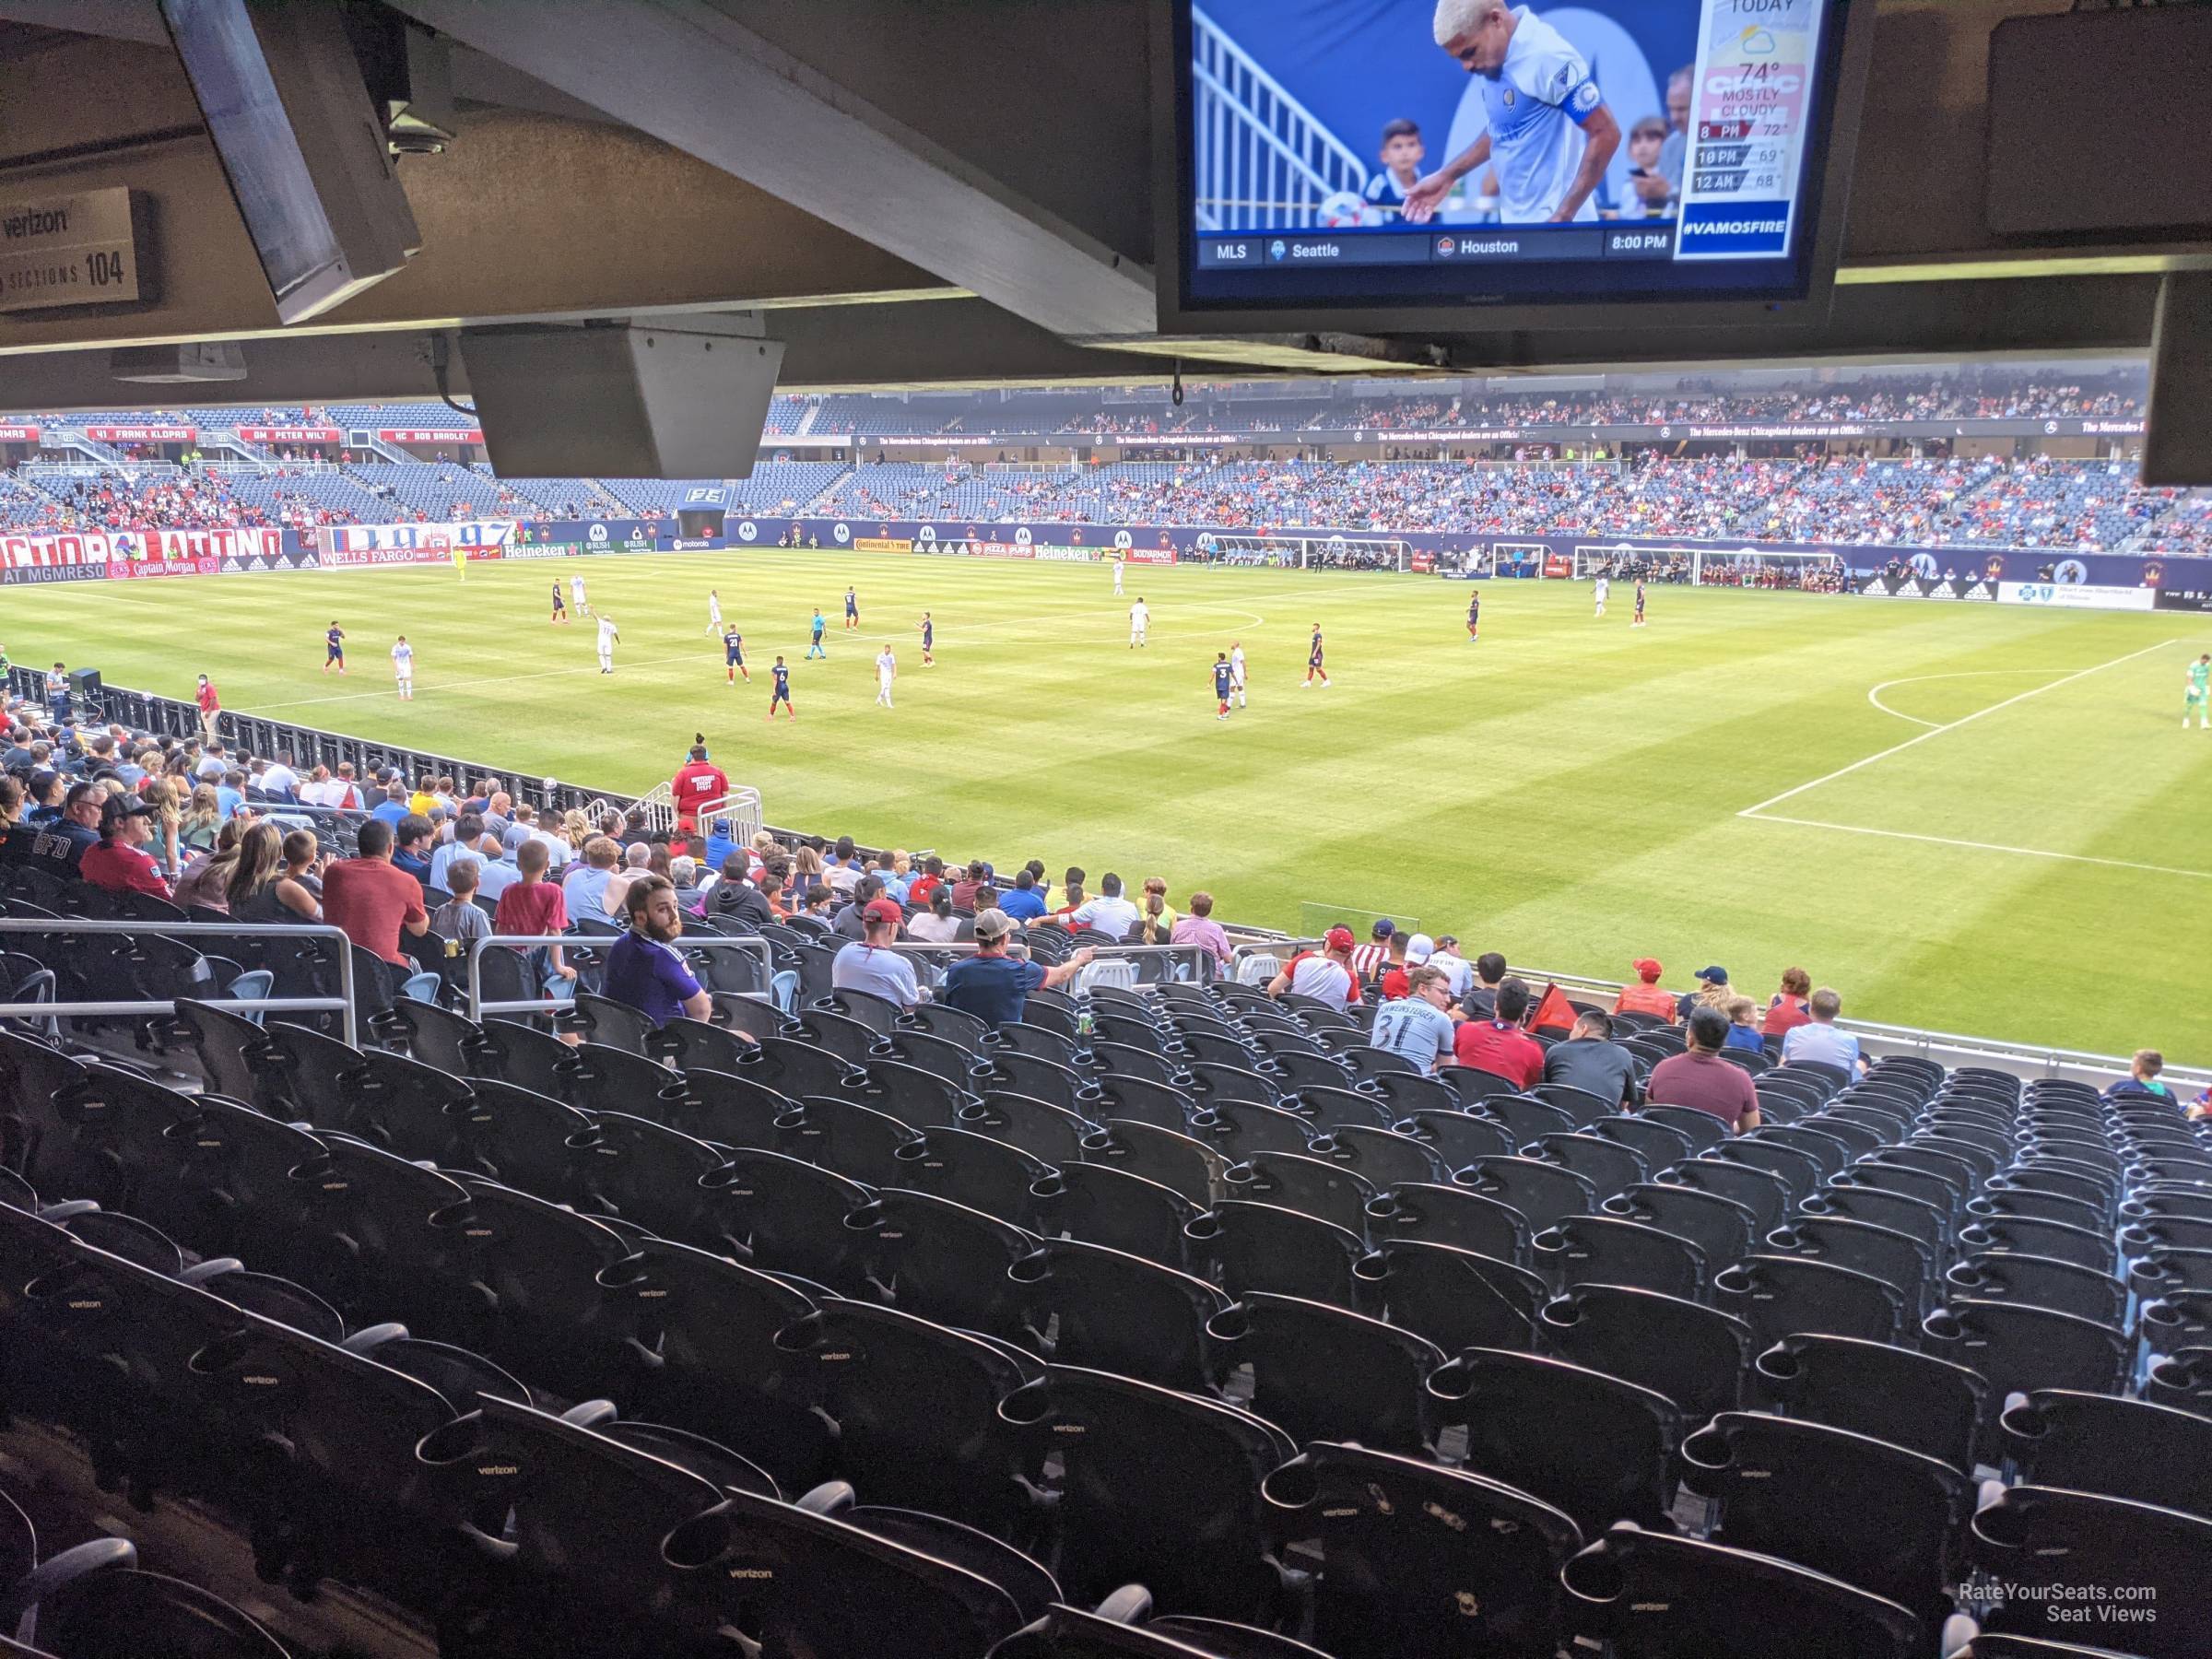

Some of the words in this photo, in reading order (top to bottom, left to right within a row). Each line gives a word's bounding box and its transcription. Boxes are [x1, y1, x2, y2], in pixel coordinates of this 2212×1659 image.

[1733, 0, 1793, 13] TODAY
[1723, 88, 1780, 101] MOSTLY
[1722, 103, 1778, 117] CLOUDY
[1700, 125, 1710, 139] 8
[1721, 125, 1739, 138] PM
[1698, 151, 1717, 164] 10
[1718, 150, 1736, 163] PM
[1696, 175, 1712, 189] 12
[1714, 175, 1734, 188] AM
[2, 206, 68, 239] verizon
[1684, 220, 1786, 235] #VAMOSFIRE
[1217, 244, 1246, 259] MLS
[1292, 243, 1339, 257] Seattle
[1461, 239, 1518, 253] Houston
[1612, 235, 1640, 249] 8:00
[1643, 234, 1667, 249] PM
[9, 265, 78, 289] SECTIONS
[86, 251, 124, 287] 104
[1689, 428, 1701, 437] The
[2082, 422, 2098, 433] The
[96, 429, 107, 439] 41
[116, 429, 147, 439] FRANK
[150, 429, 188, 439] KLOPAS
[276, 430, 304, 440] PETER
[305, 430, 326, 440] WILT
[433, 432, 469, 441] BRADLEY
[1378, 432, 1388, 441] The
[879, 438, 888, 446] The
[1116, 436, 1124, 444] The
[593, 541, 610, 549] RUSH
[856, 538, 890, 549] Continental
[505, 544, 566, 559] Heineken
[1035, 545, 1089, 561] Heineken
[1134, 549, 1172, 559] BODYARMOR
[323, 553, 367, 565] WELLS
[371, 550, 414, 563] FARGO
[134, 560, 164, 576] Captain
[164, 559, 196, 575] Morgan
[4, 569, 22, 583] AT
[28, 565, 105, 582] MGMRESO
[780, 672, 785, 681] 6
[1219, 668, 1227, 678] 3
[1376, 1014, 1414, 1053] 31
[465, 1228, 493, 1237] verizon
[638, 1289, 668, 1298] verizon
[68, 1300, 102, 1309] verizon
[819, 1351, 852, 1361] verizon
[242, 1375, 279, 1385] verizon
[1052, 1423, 1086, 1433] verizon
[477, 1465, 519, 1476] verizon
[1322, 1507, 1359, 1518] verizon
[729, 1568, 773, 1580] verizon
[1630, 1601, 1670, 1612] verizon
